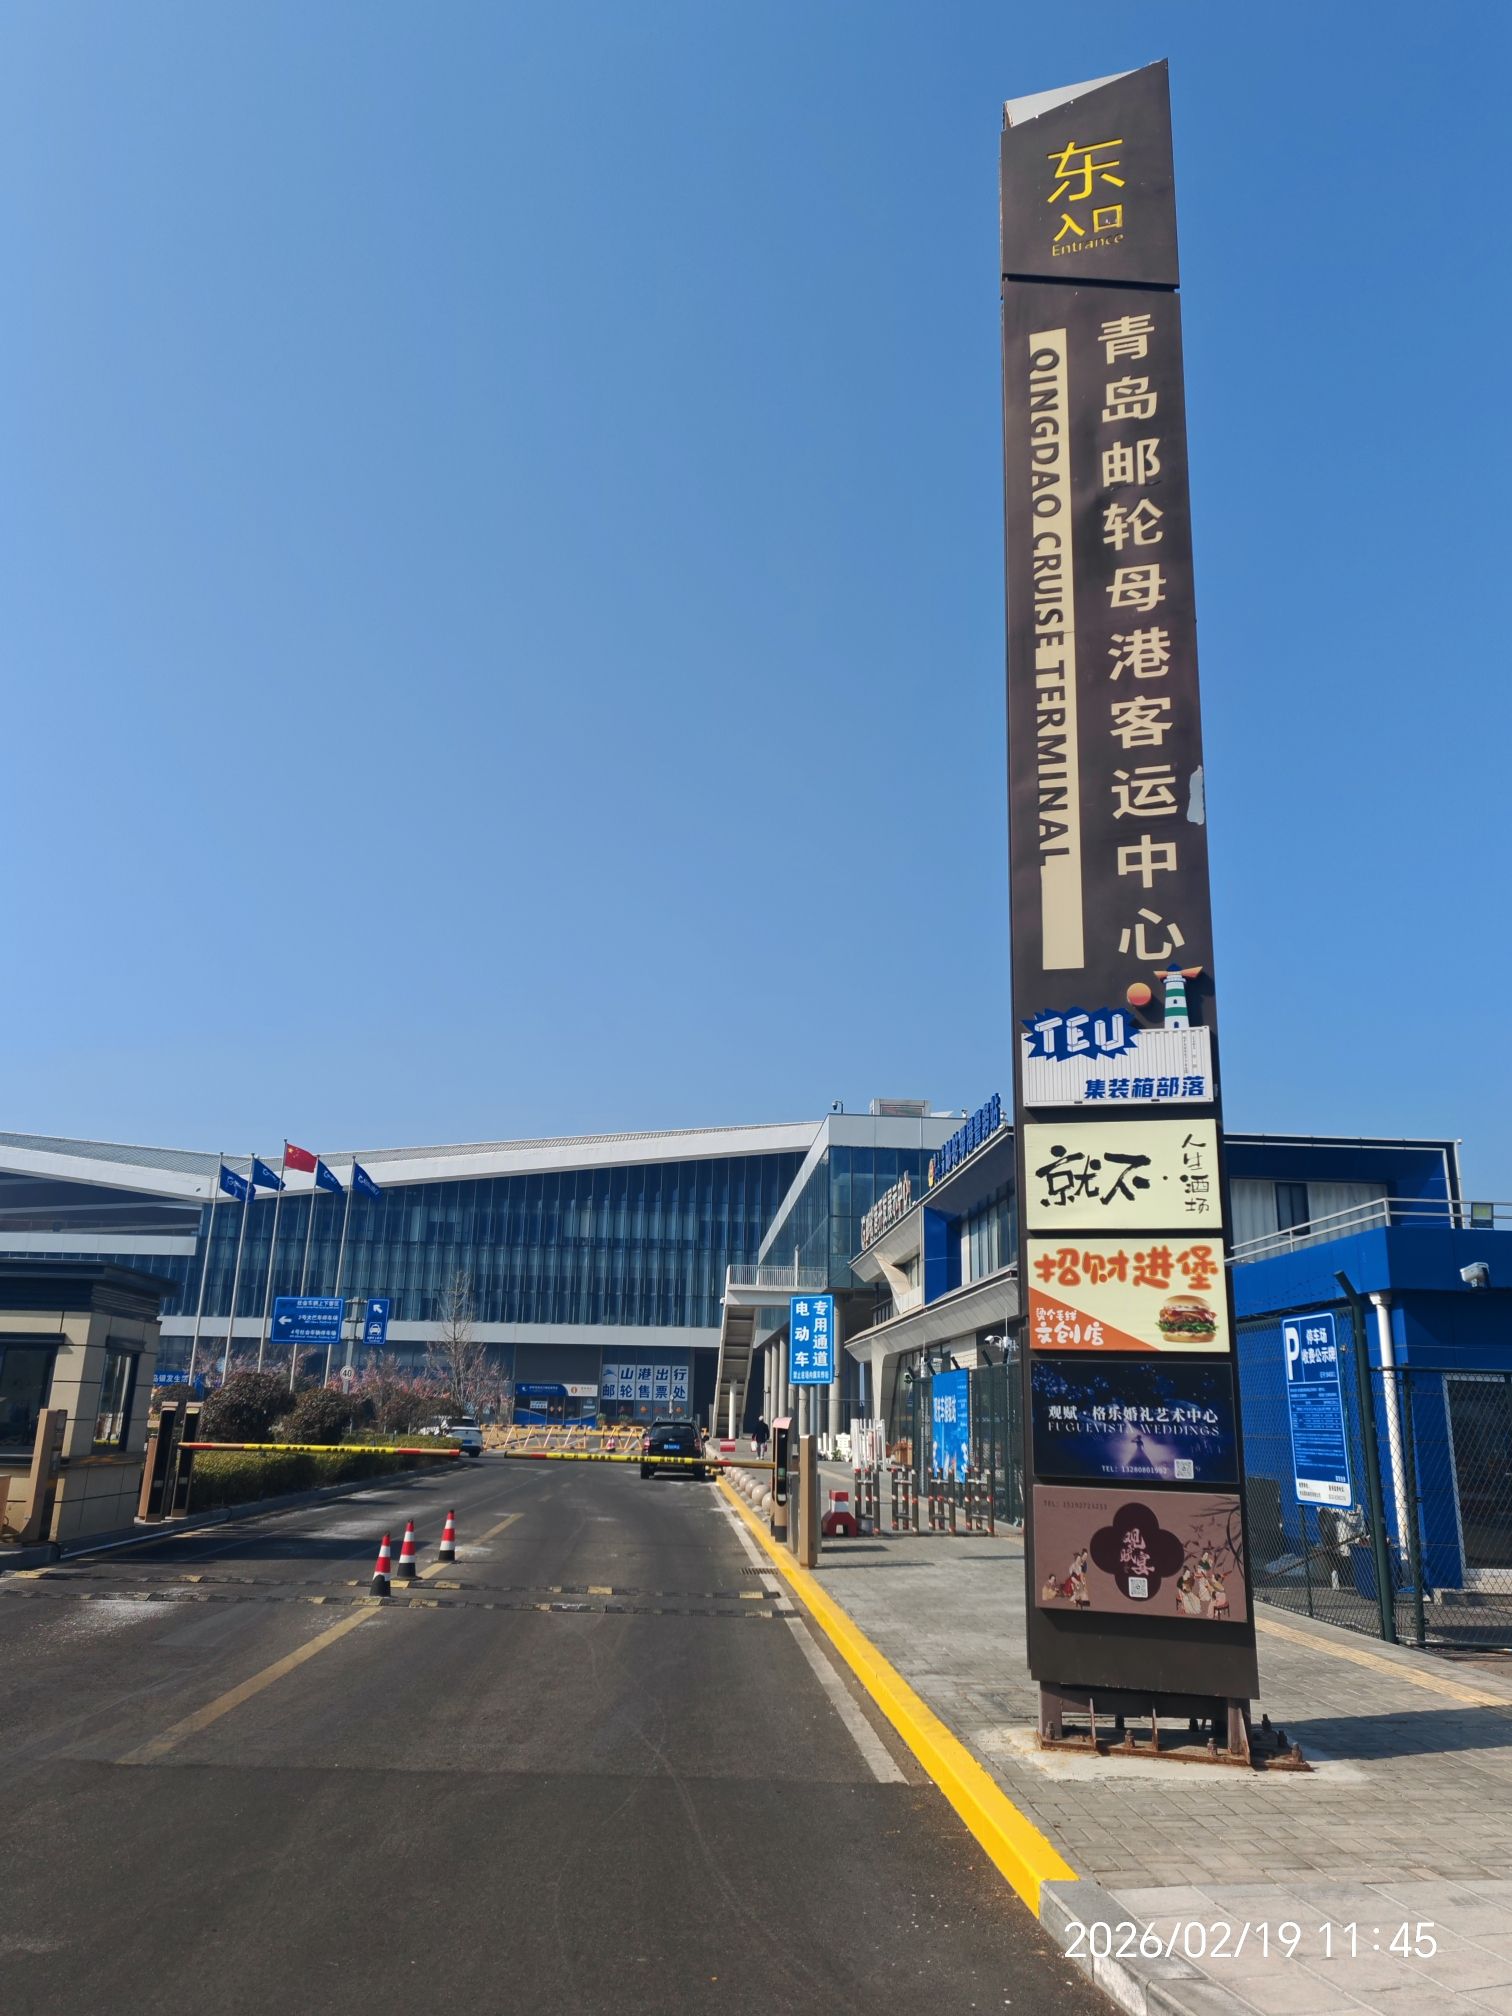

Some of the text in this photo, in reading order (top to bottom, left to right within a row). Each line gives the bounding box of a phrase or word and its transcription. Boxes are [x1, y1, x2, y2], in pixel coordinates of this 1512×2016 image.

[1046, 139, 1126, 203] 东
[1053, 204, 1124, 242] 入口
[1052, 233, 1124, 257] Entrance
[1029, 347, 1071, 866] QINGDAO CRUISE TERMINAL
[1097, 313, 1186, 961] 青岛邮轮母港客运中心
[1034, 1013, 1125, 1053] TEU
[1083, 1075, 1205, 1100] 集装箱部落
[1033, 1244, 1219, 1291] 招财进堡
[794, 1301, 810, 1367] 电动车
[813, 1300, 829, 1367] 专用通道
[1034, 1321, 1105, 1346] 文创店
[1306, 1327, 1328, 1345] 停车场
[1285, 1326, 1300, 1381] P
[342, 1369, 353, 1377] 40
[602, 1384, 686, 1399] 邮轮售票处
[620, 1367, 687, 1381] 山港出行
[1140, 1423, 1220, 1437] WEDDINGS
